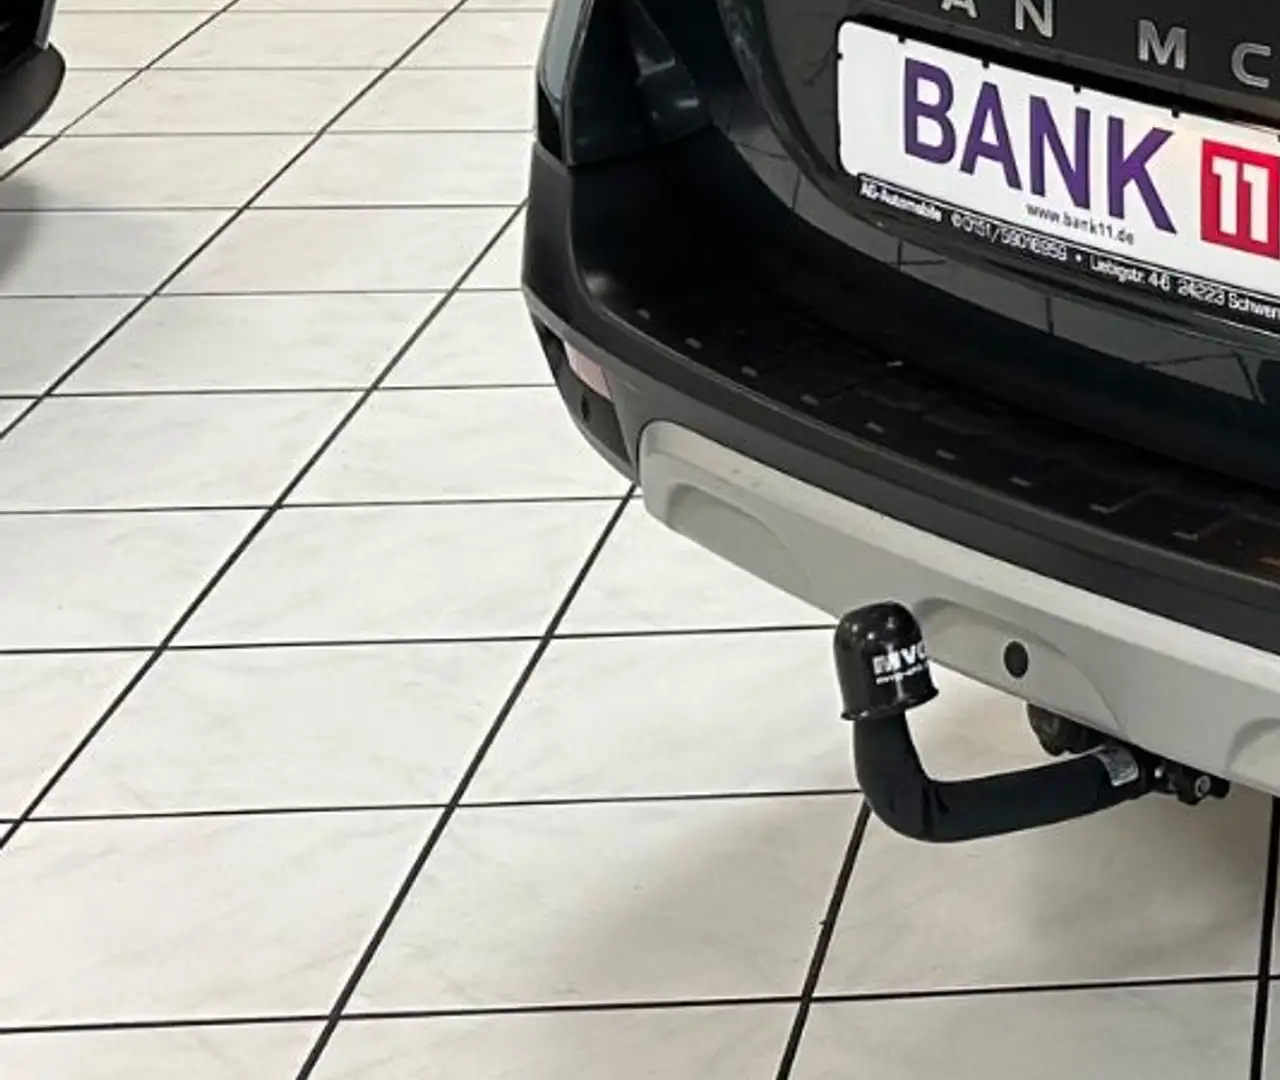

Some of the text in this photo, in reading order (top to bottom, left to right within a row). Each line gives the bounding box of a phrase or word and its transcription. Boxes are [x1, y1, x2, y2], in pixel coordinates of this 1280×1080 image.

[903, 56, 1271, 245] BANK 11
[1026, 203, 1136, 245] www.bank11.de
